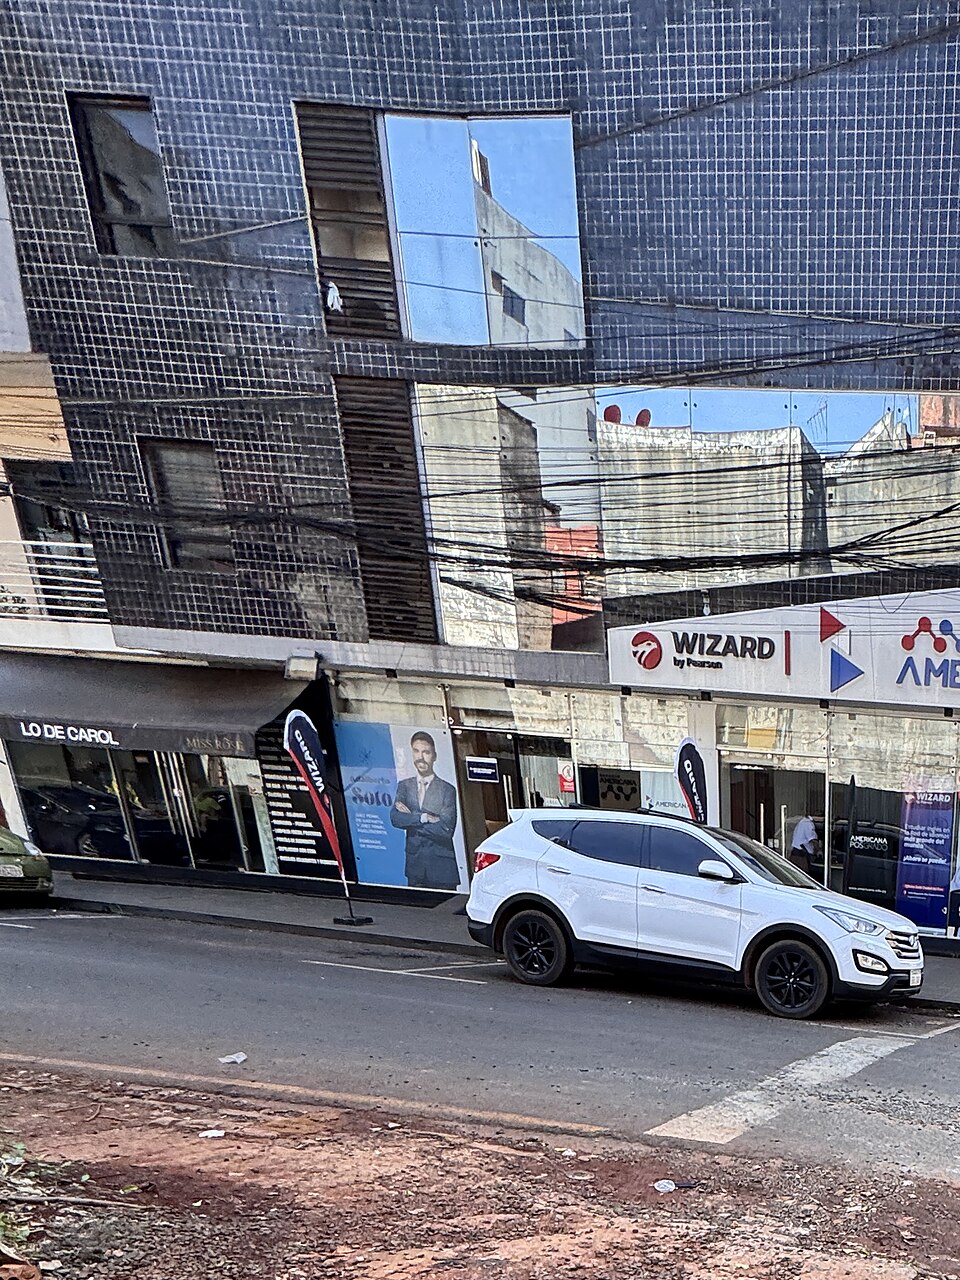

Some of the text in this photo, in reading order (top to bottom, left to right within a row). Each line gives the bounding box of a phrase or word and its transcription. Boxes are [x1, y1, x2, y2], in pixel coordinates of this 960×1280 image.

[671, 630, 776, 660] WIZARD
[673, 656, 723, 670] by Pearson
[20, 722, 120, 746] LO DE CAROL
[294, 729, 326, 794] WIZARD
[351, 785, 393, 808] Soto
[916, 792, 951, 803] WIZARD
[849, 835, 888, 845] AMERICANA
[849, 841, 889, 852] POSGRADO
